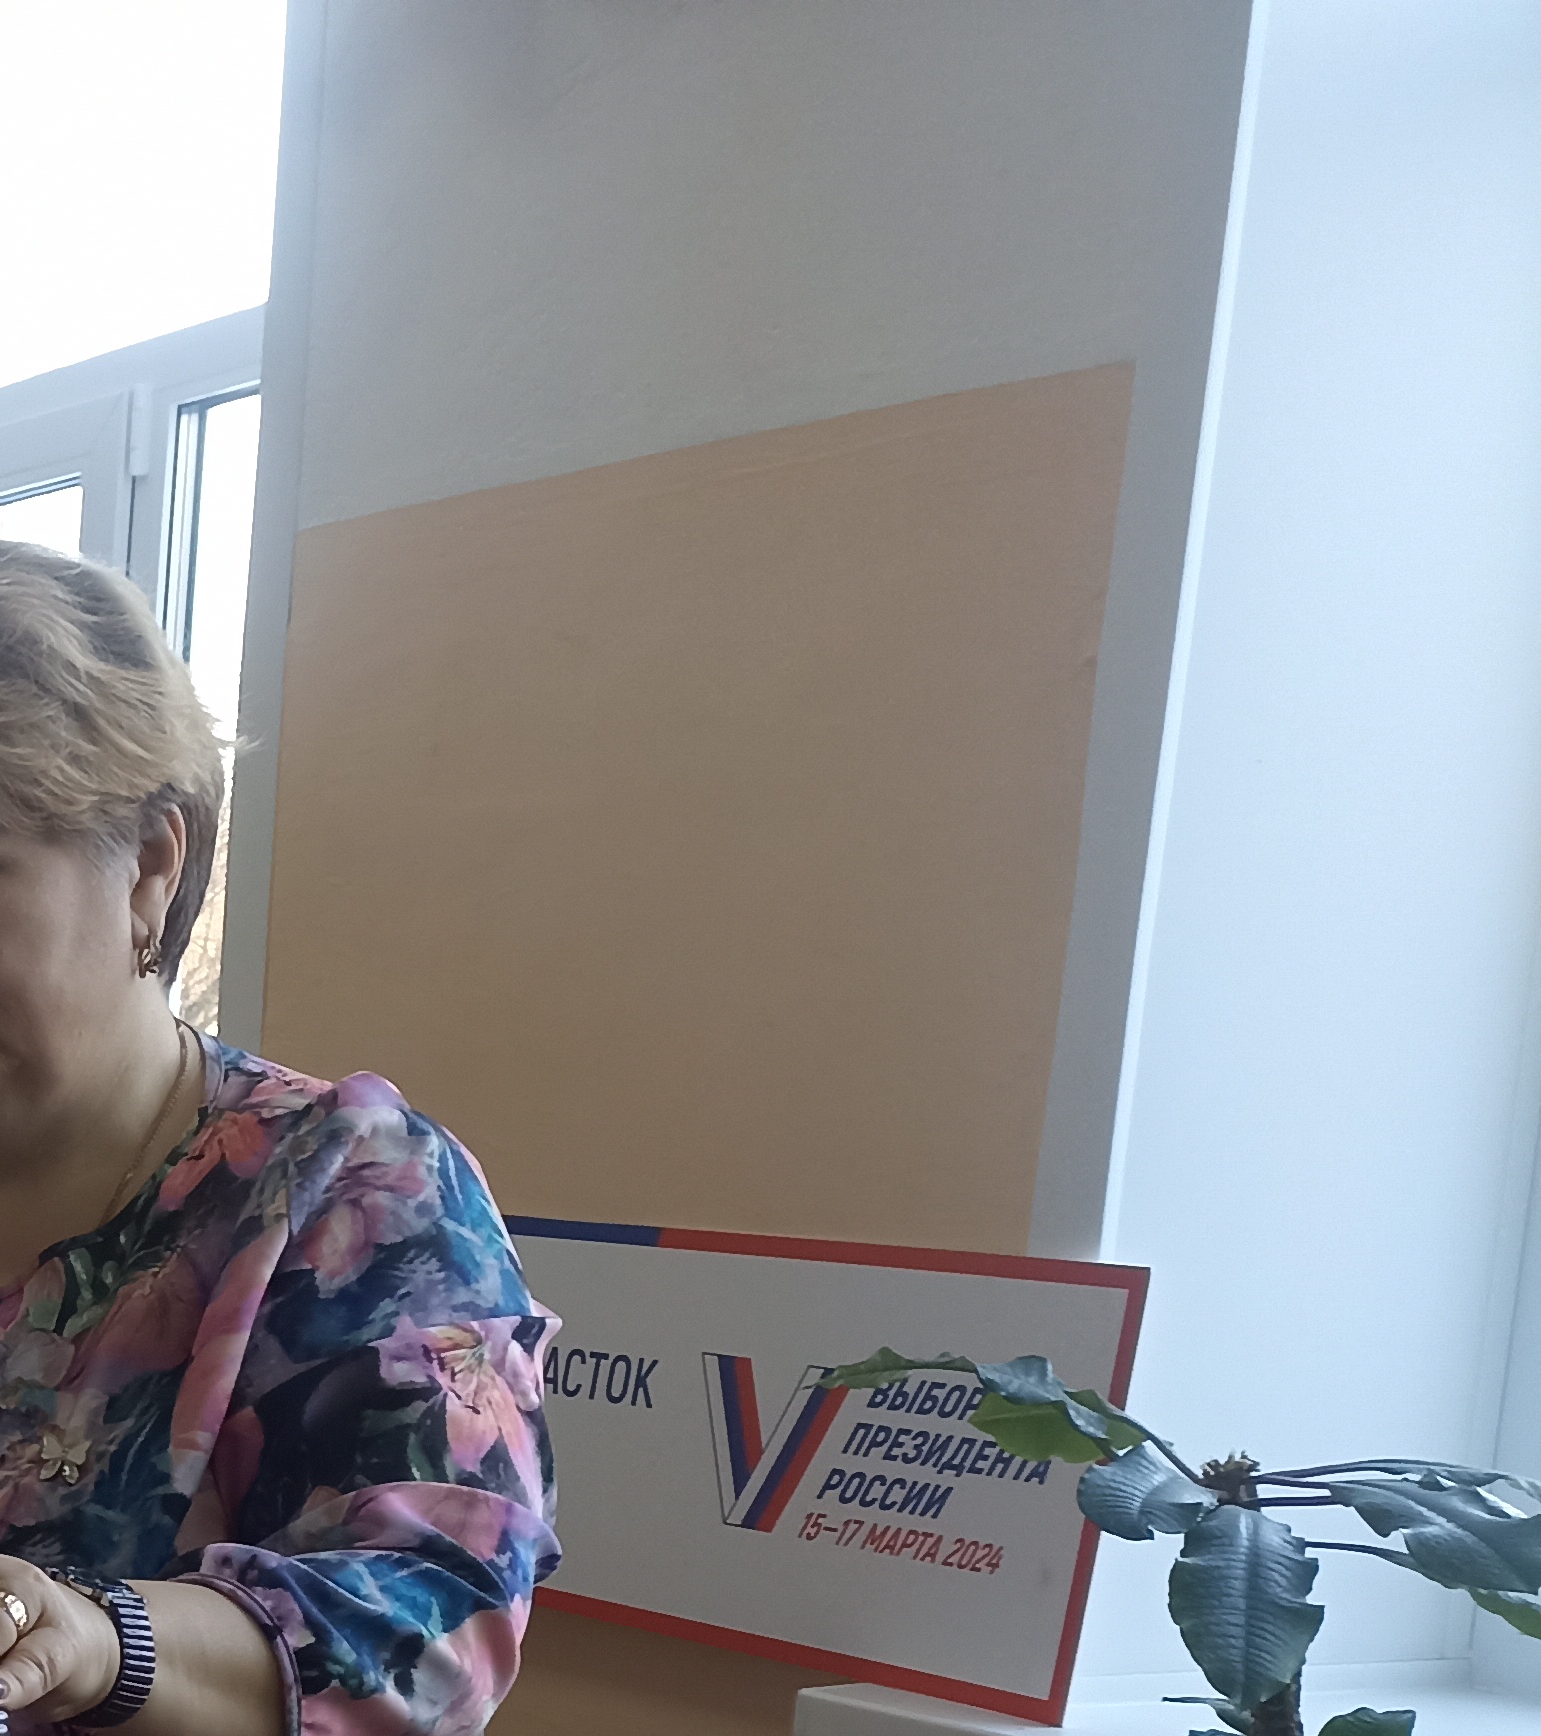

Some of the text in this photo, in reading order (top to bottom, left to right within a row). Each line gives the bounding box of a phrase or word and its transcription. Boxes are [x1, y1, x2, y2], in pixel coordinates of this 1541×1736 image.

[543, 1346, 659, 1409] АСТОК
[866, 1377, 986, 1421] ВЫБОР
[816, 1467, 954, 1519] РОССИИ
[860, 1522, 944, 1564] МАРТА
[941, 1537, 1005, 1575] 2024
